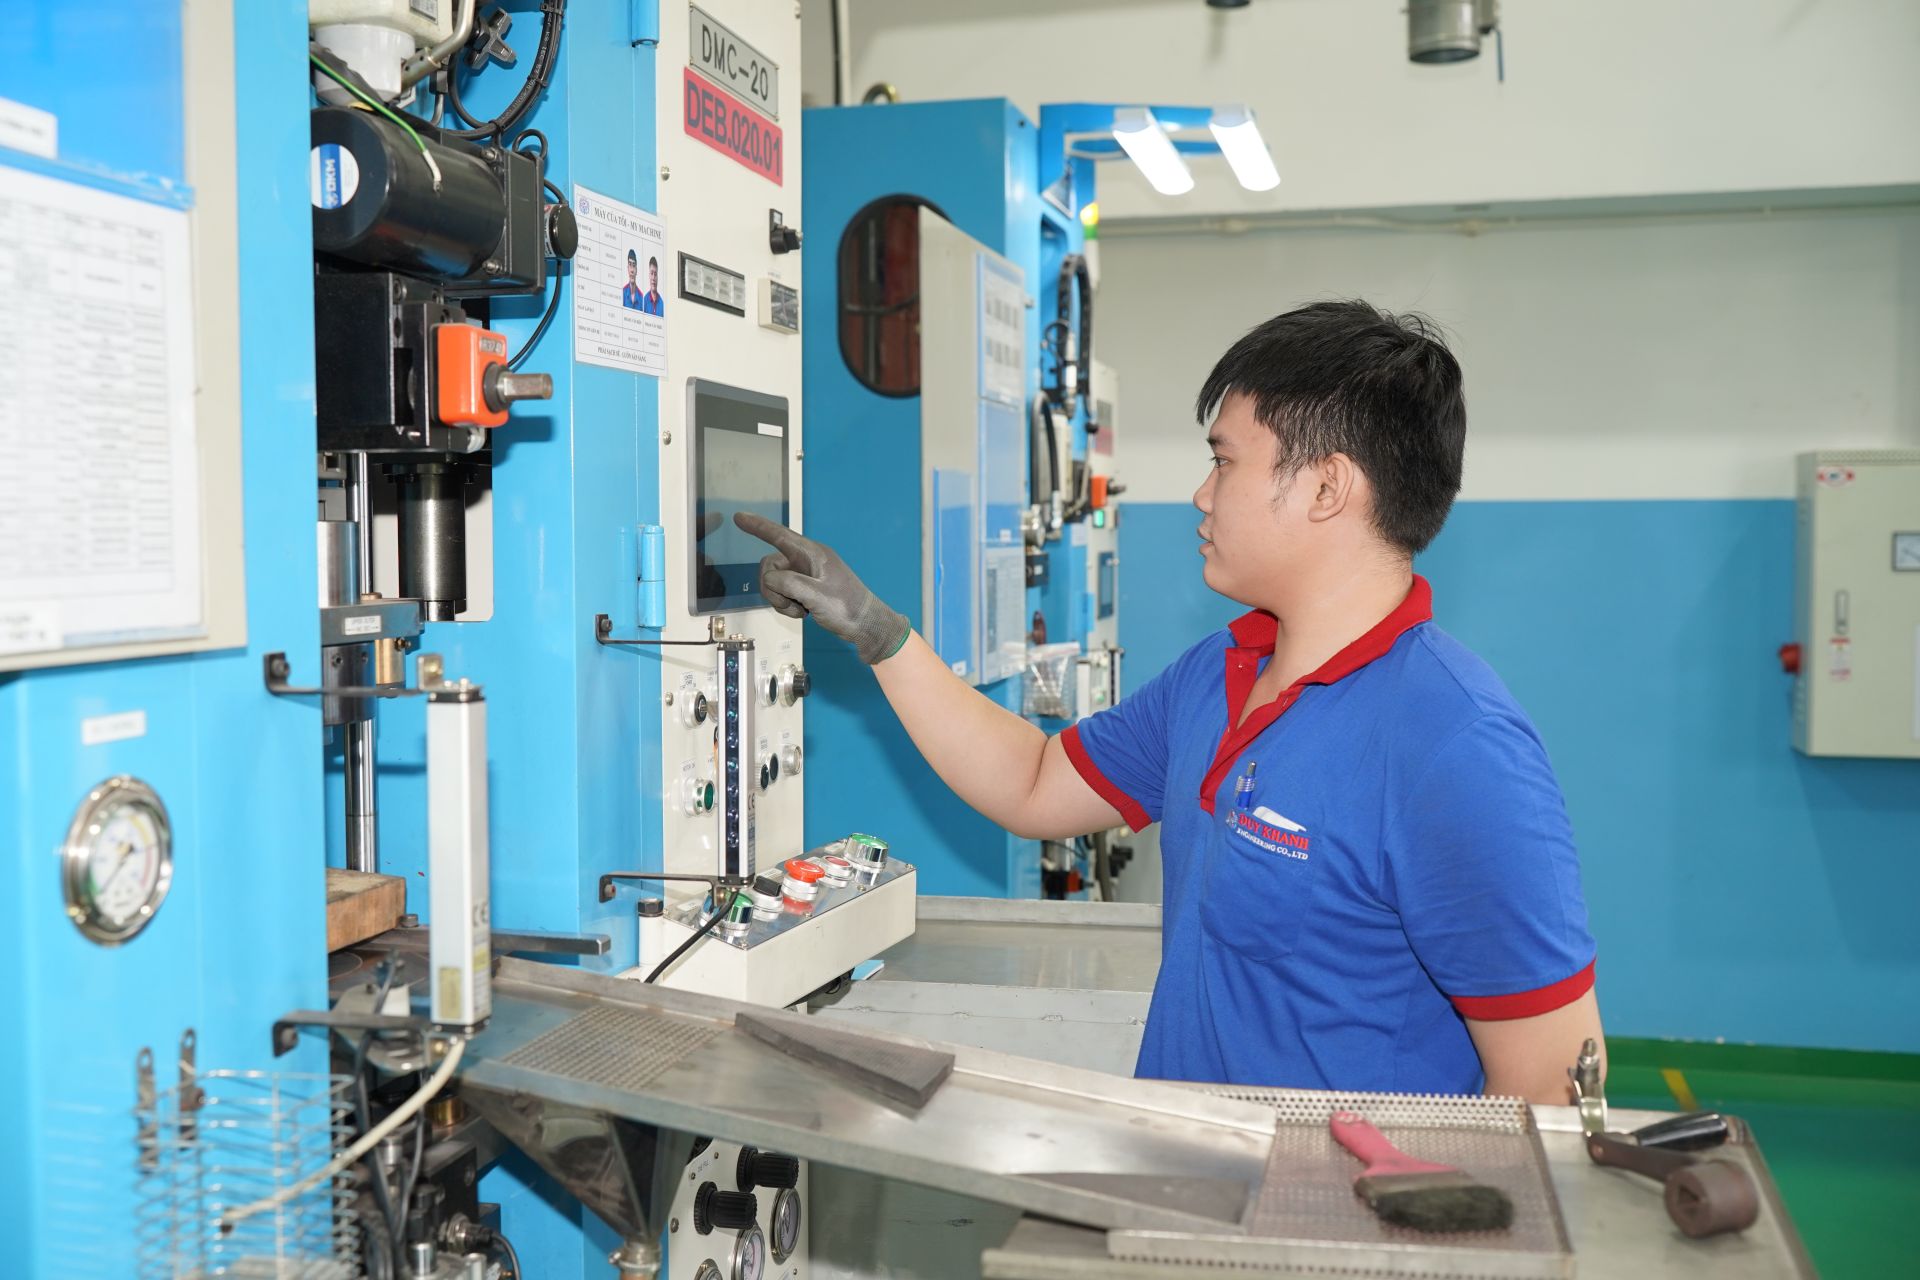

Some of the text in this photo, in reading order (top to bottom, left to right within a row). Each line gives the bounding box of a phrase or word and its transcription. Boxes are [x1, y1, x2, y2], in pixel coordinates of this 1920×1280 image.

[702, 23, 769, 101] DMC-20
[687, 79, 780, 177] DEB.020.01
[639, 225, 661, 239] MACHINE
[1238, 813, 1309, 850] DUY KHANH
